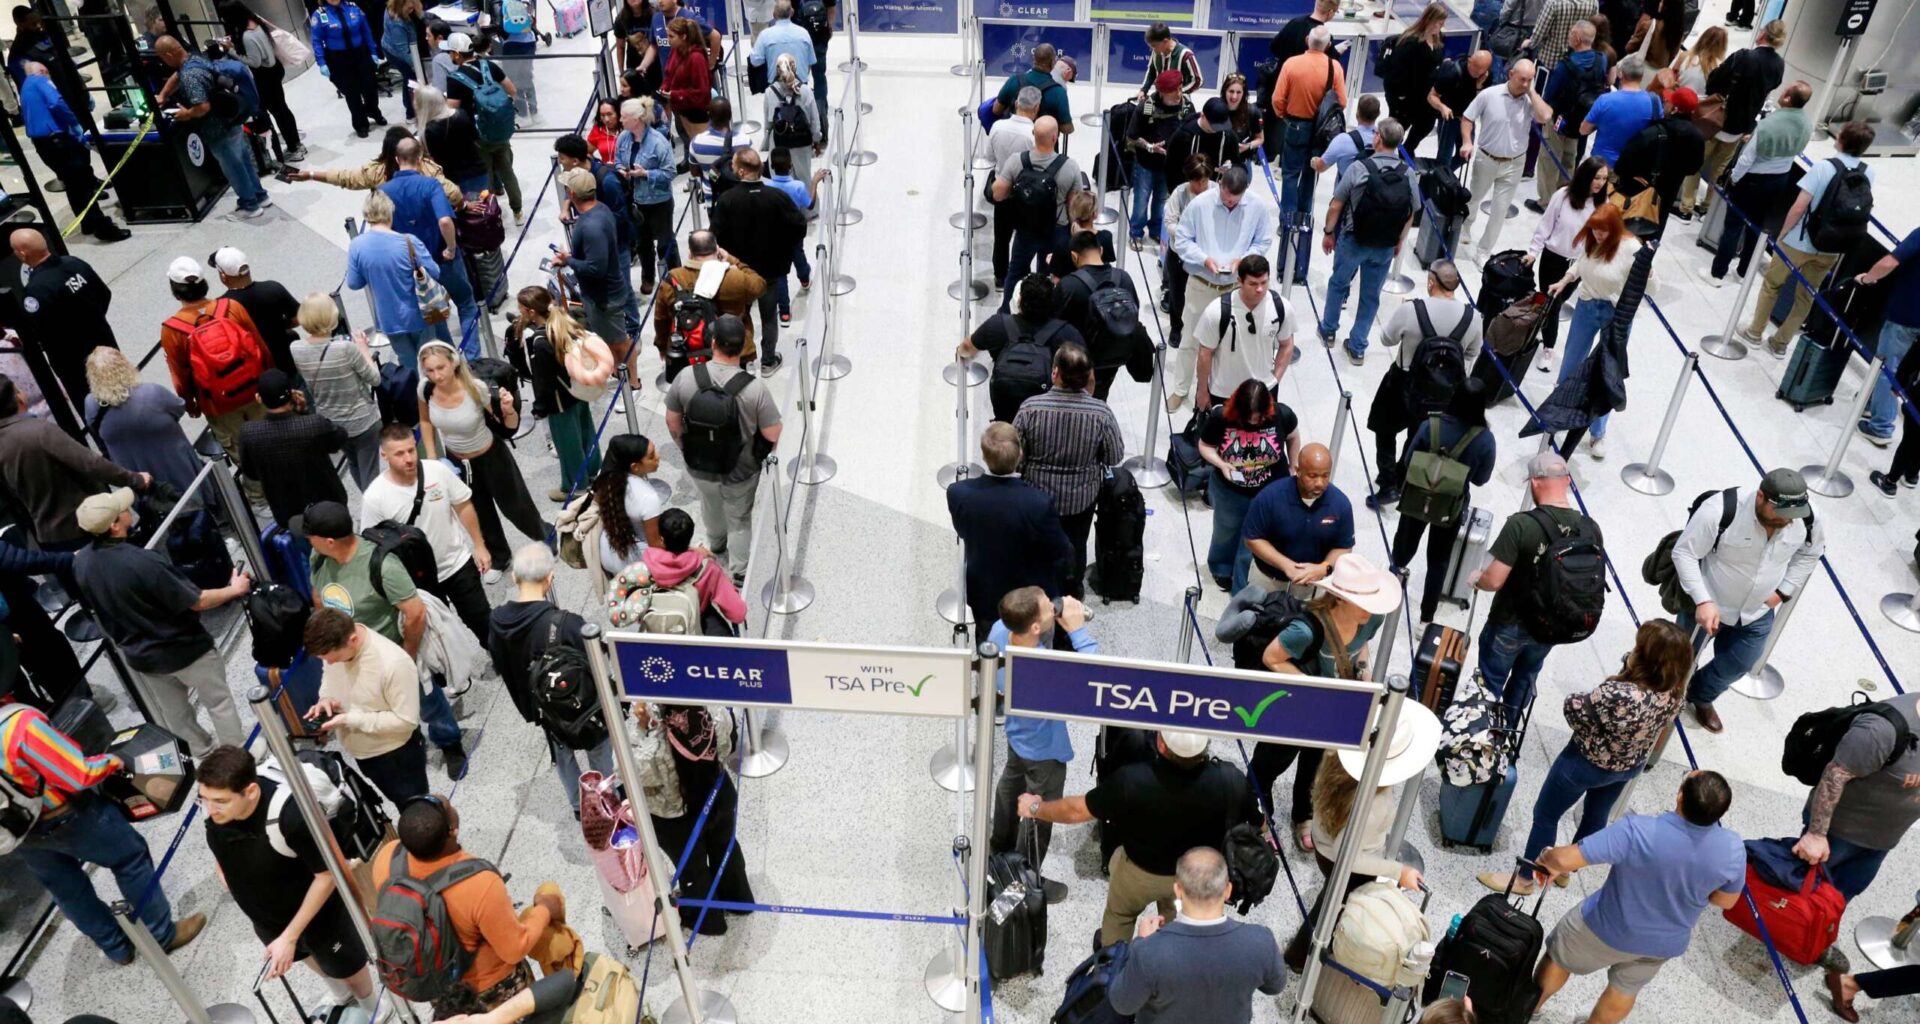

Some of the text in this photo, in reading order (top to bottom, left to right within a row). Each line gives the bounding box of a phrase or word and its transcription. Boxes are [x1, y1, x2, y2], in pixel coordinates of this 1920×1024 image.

[1017, 7, 1049, 15] CLEAR
[65, 273, 87, 293] TSA
[686, 665, 763, 681] CLEAR
[860, 665, 893, 674] WITH
[739, 681, 763, 689] PLUS
[825, 675, 905, 694] TSA Pre
[1087, 681, 1231, 720] TSA Pre
